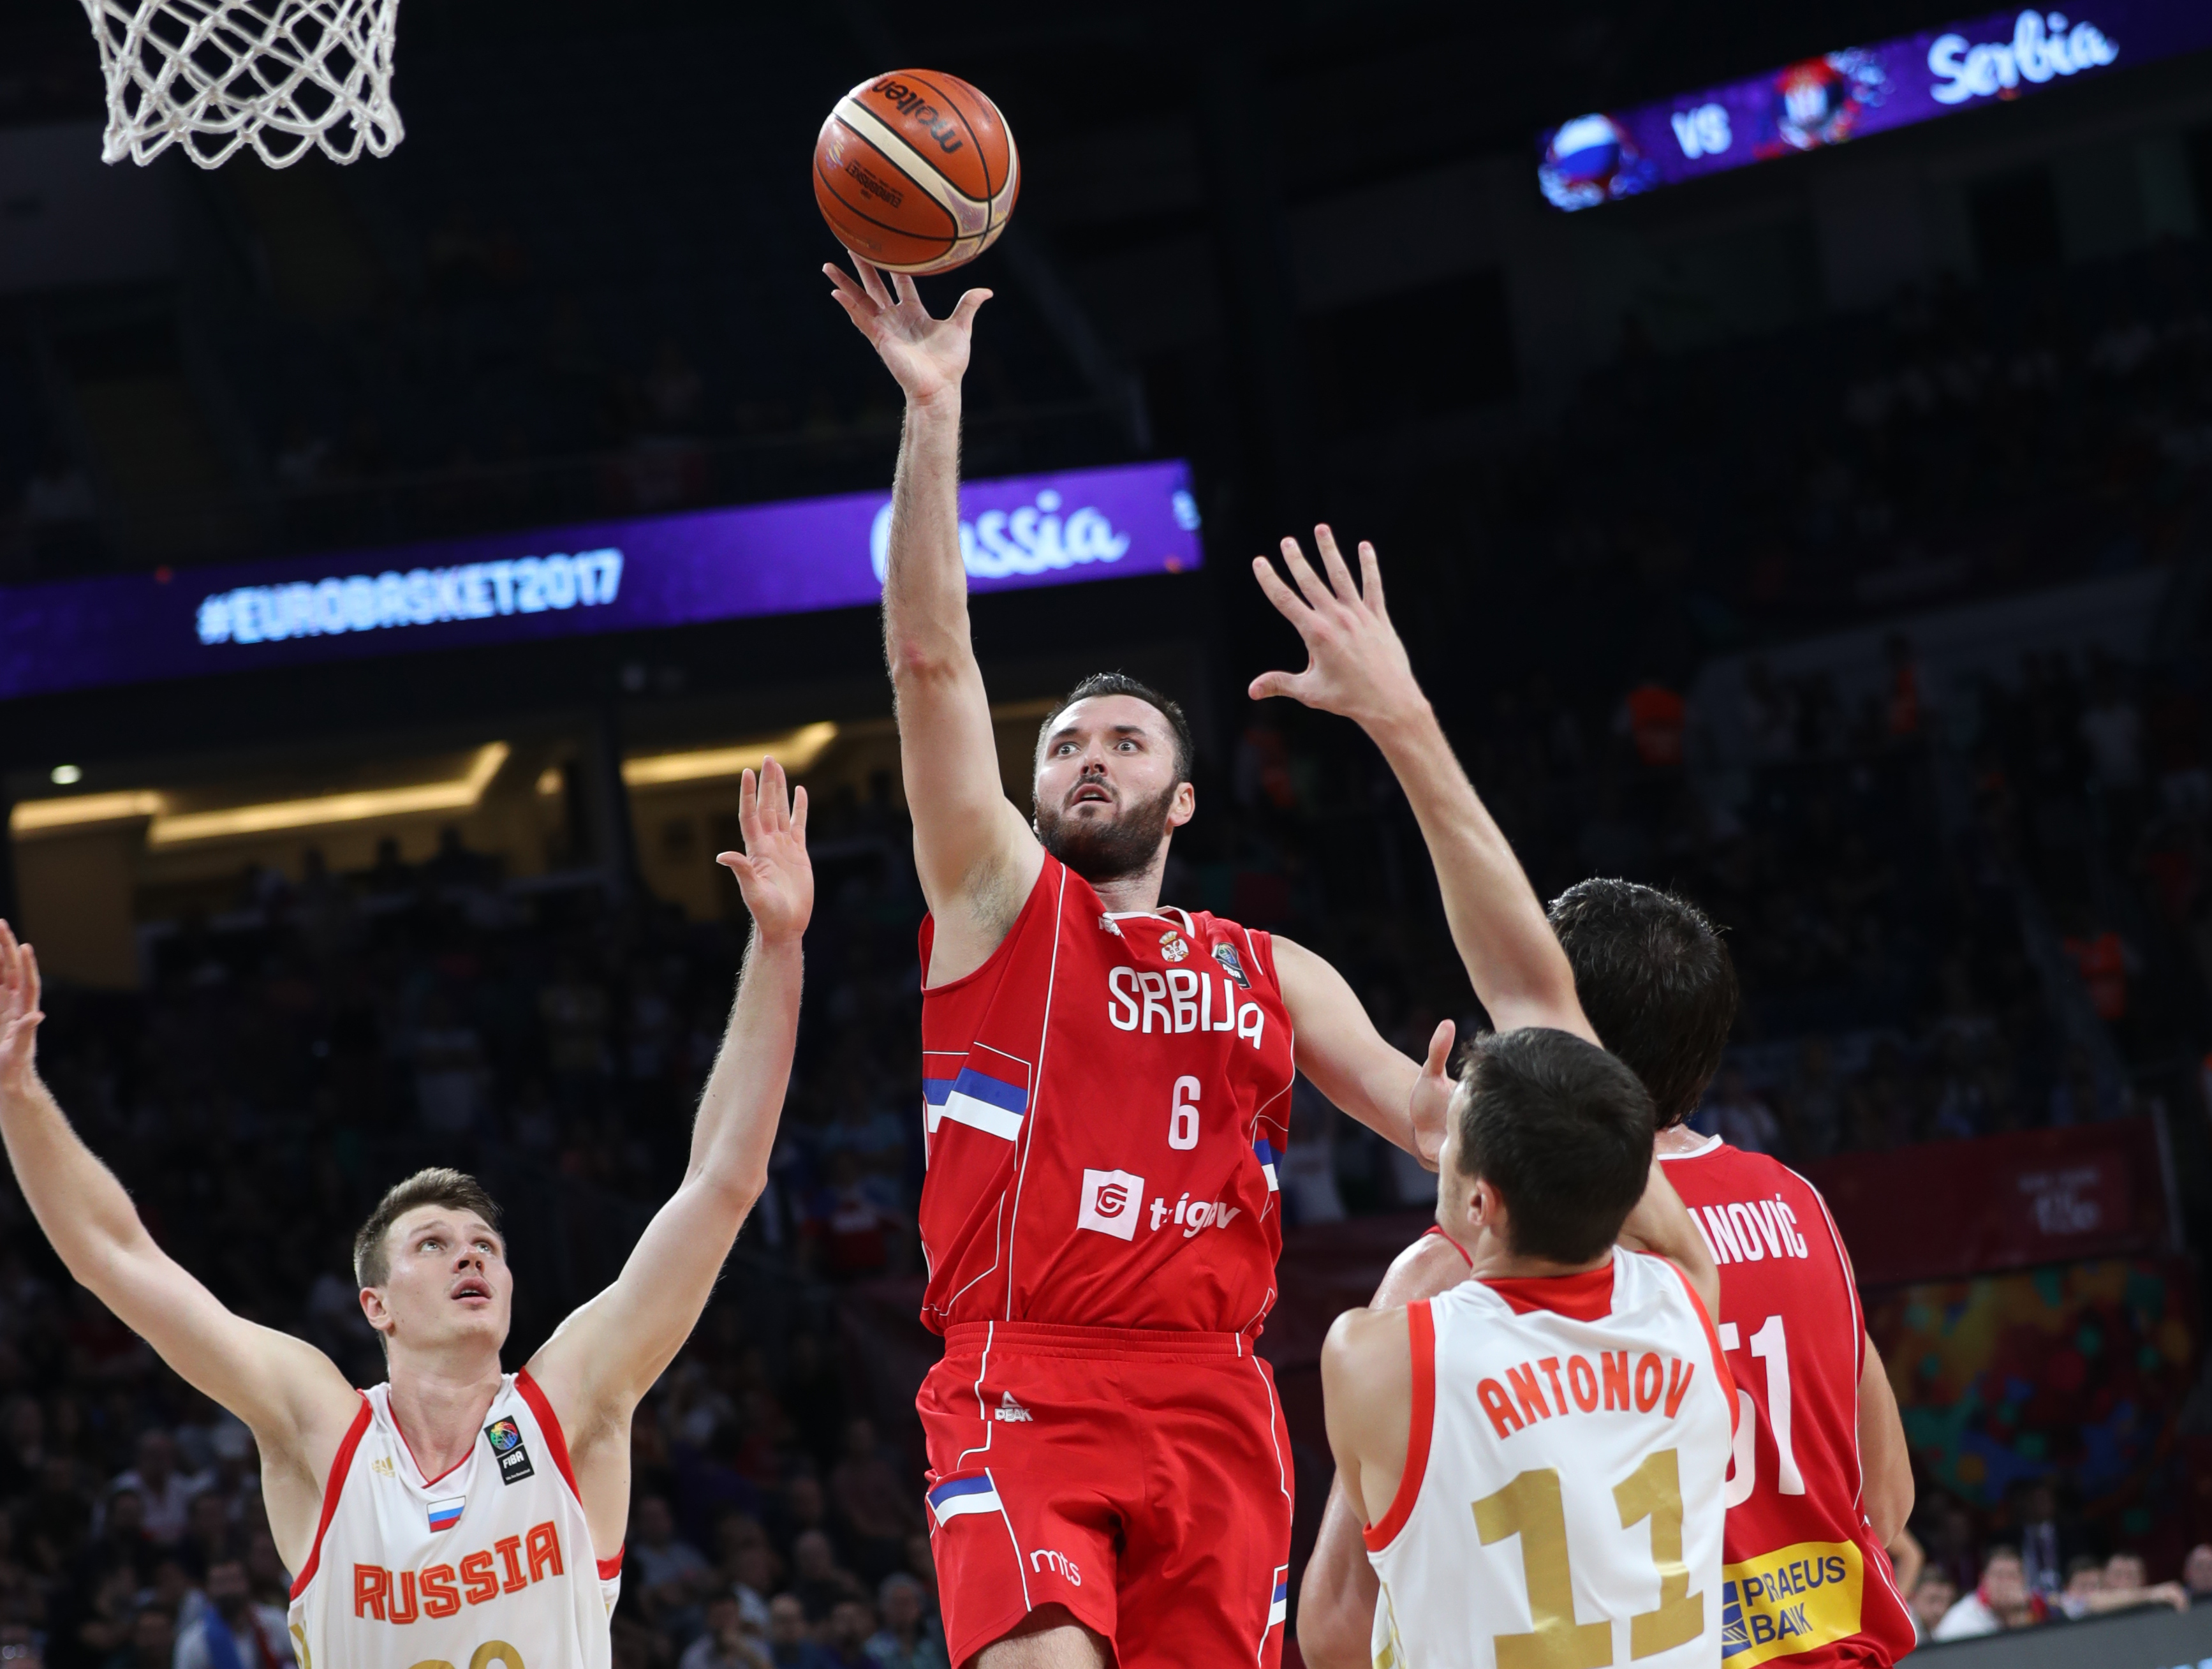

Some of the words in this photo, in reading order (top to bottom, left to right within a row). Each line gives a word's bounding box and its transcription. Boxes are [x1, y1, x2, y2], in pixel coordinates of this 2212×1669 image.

[1927, 8, 2120, 105] Serbia
[871, 78, 964, 155] molten
[1671, 103, 1734, 159] VS
[869, 489, 1131, 584] ssia
[196, 547, 624, 645] #EUROBASKET2017
[1168, 1075, 1201, 1150] 6
[994, 1407, 1034, 1423] PEAK
[1476, 1350, 1695, 1441] ANTONOV
[502, 1450, 525, 1469] FIBA
[353, 1520, 564, 1625] RUSSIA
[1029, 1548, 1082, 1587] mts
[1471, 1446, 1705, 1669] 11
